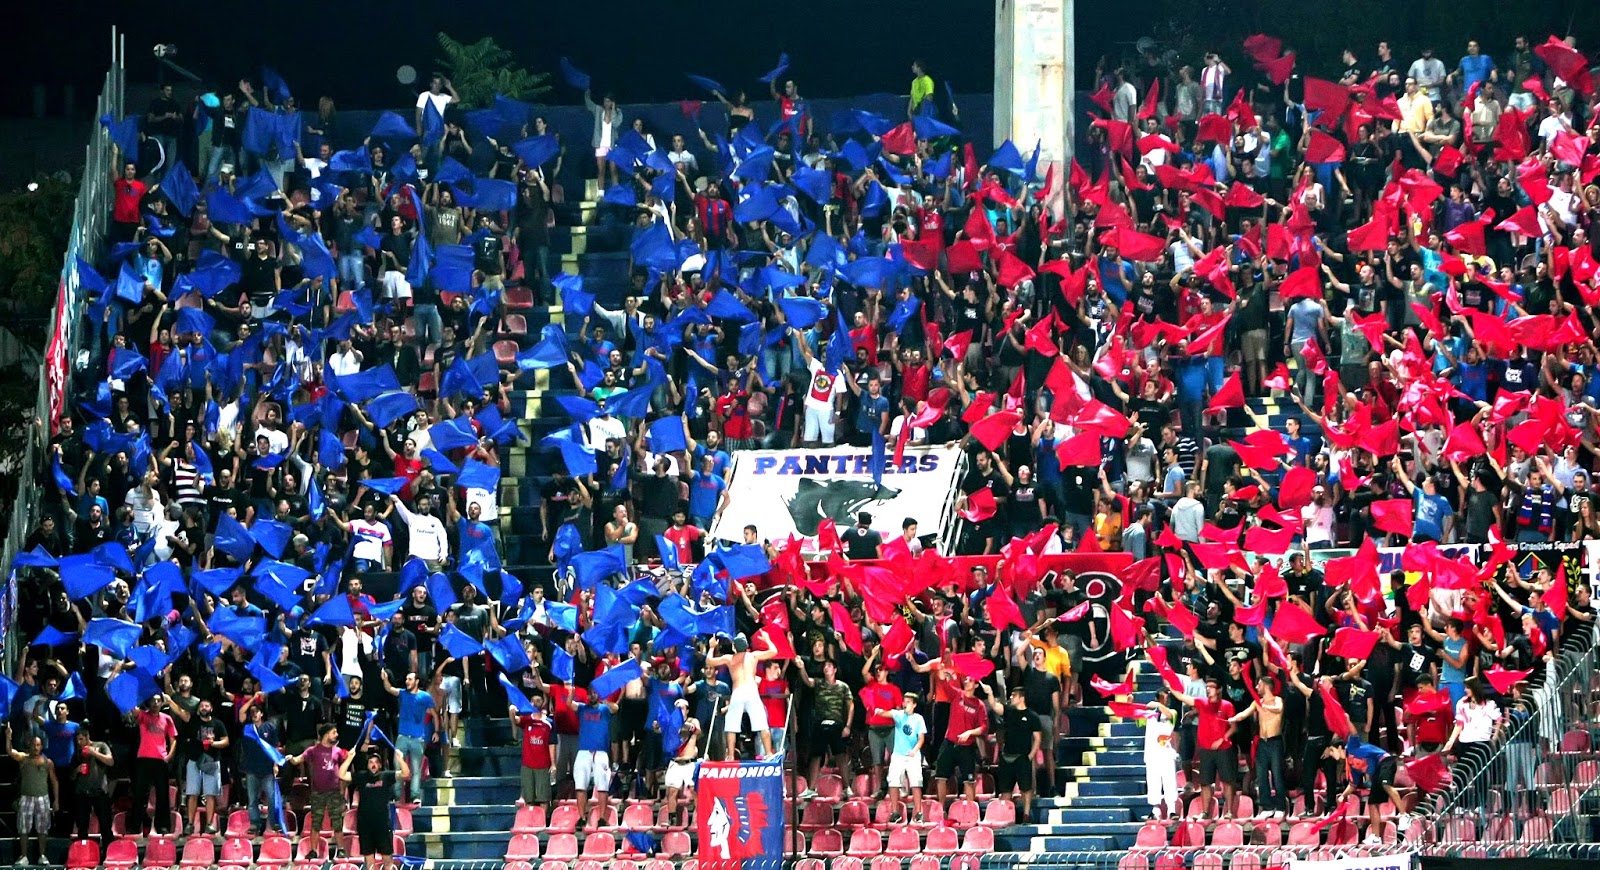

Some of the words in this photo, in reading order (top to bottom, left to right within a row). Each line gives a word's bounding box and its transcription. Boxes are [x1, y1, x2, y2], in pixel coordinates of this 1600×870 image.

[753, 455, 939, 475] PANTHERS
[1520, 541, 1553, 551] Creative
[1554, 540, 1580, 552] Squad
[699, 766, 781, 779] PANIONIOS
